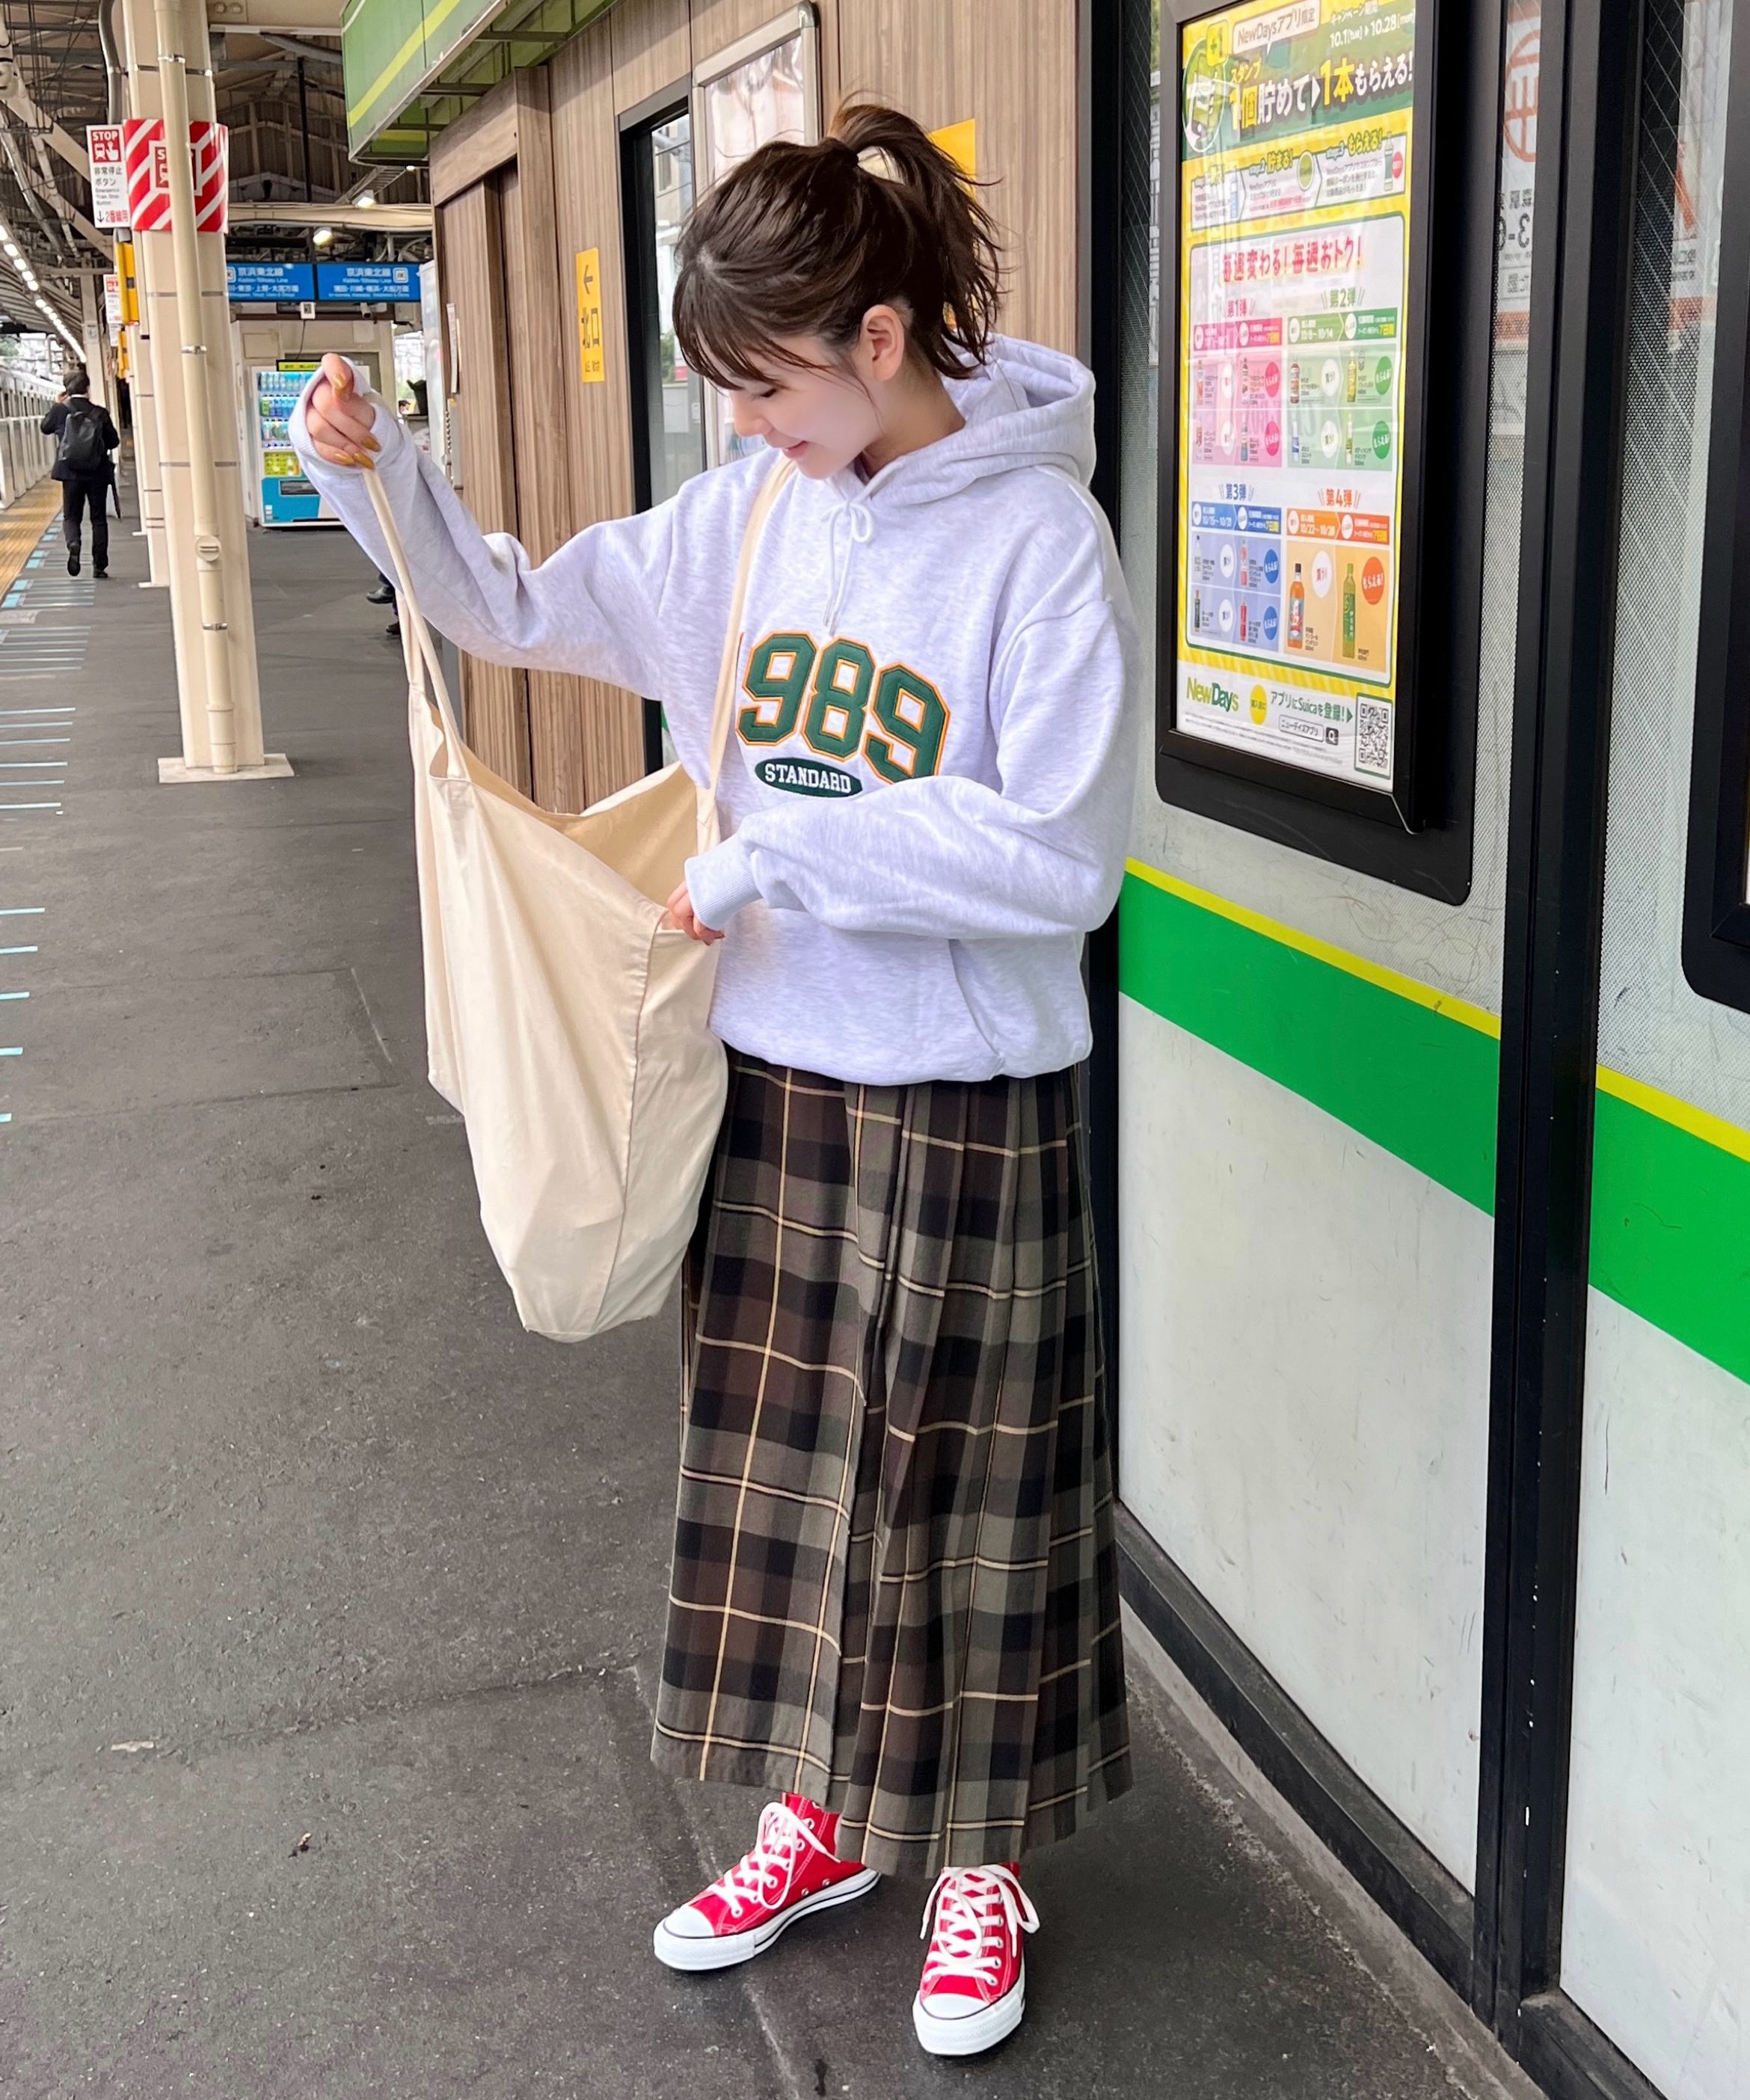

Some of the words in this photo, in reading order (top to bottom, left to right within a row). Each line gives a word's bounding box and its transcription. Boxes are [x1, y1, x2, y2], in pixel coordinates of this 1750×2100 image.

[1229, 58, 1262, 85] スタンプ
[1319, 50, 1413, 105] 1本もらえる!
[93, 131, 118, 141] STOP
[1348, 129, 1383, 157] もらえる!
[95, 177, 117, 186] ボタン
[1330, 287, 1356, 308] 第2弾
[1326, 488, 1353, 508] 第4弾
[735, 629, 952, 785] 989
[1186, 676, 1239, 712] NewDays
[1270, 690, 1345, 722] アプリにSuicaを登録!
[764, 763, 853, 793] STANDARD
